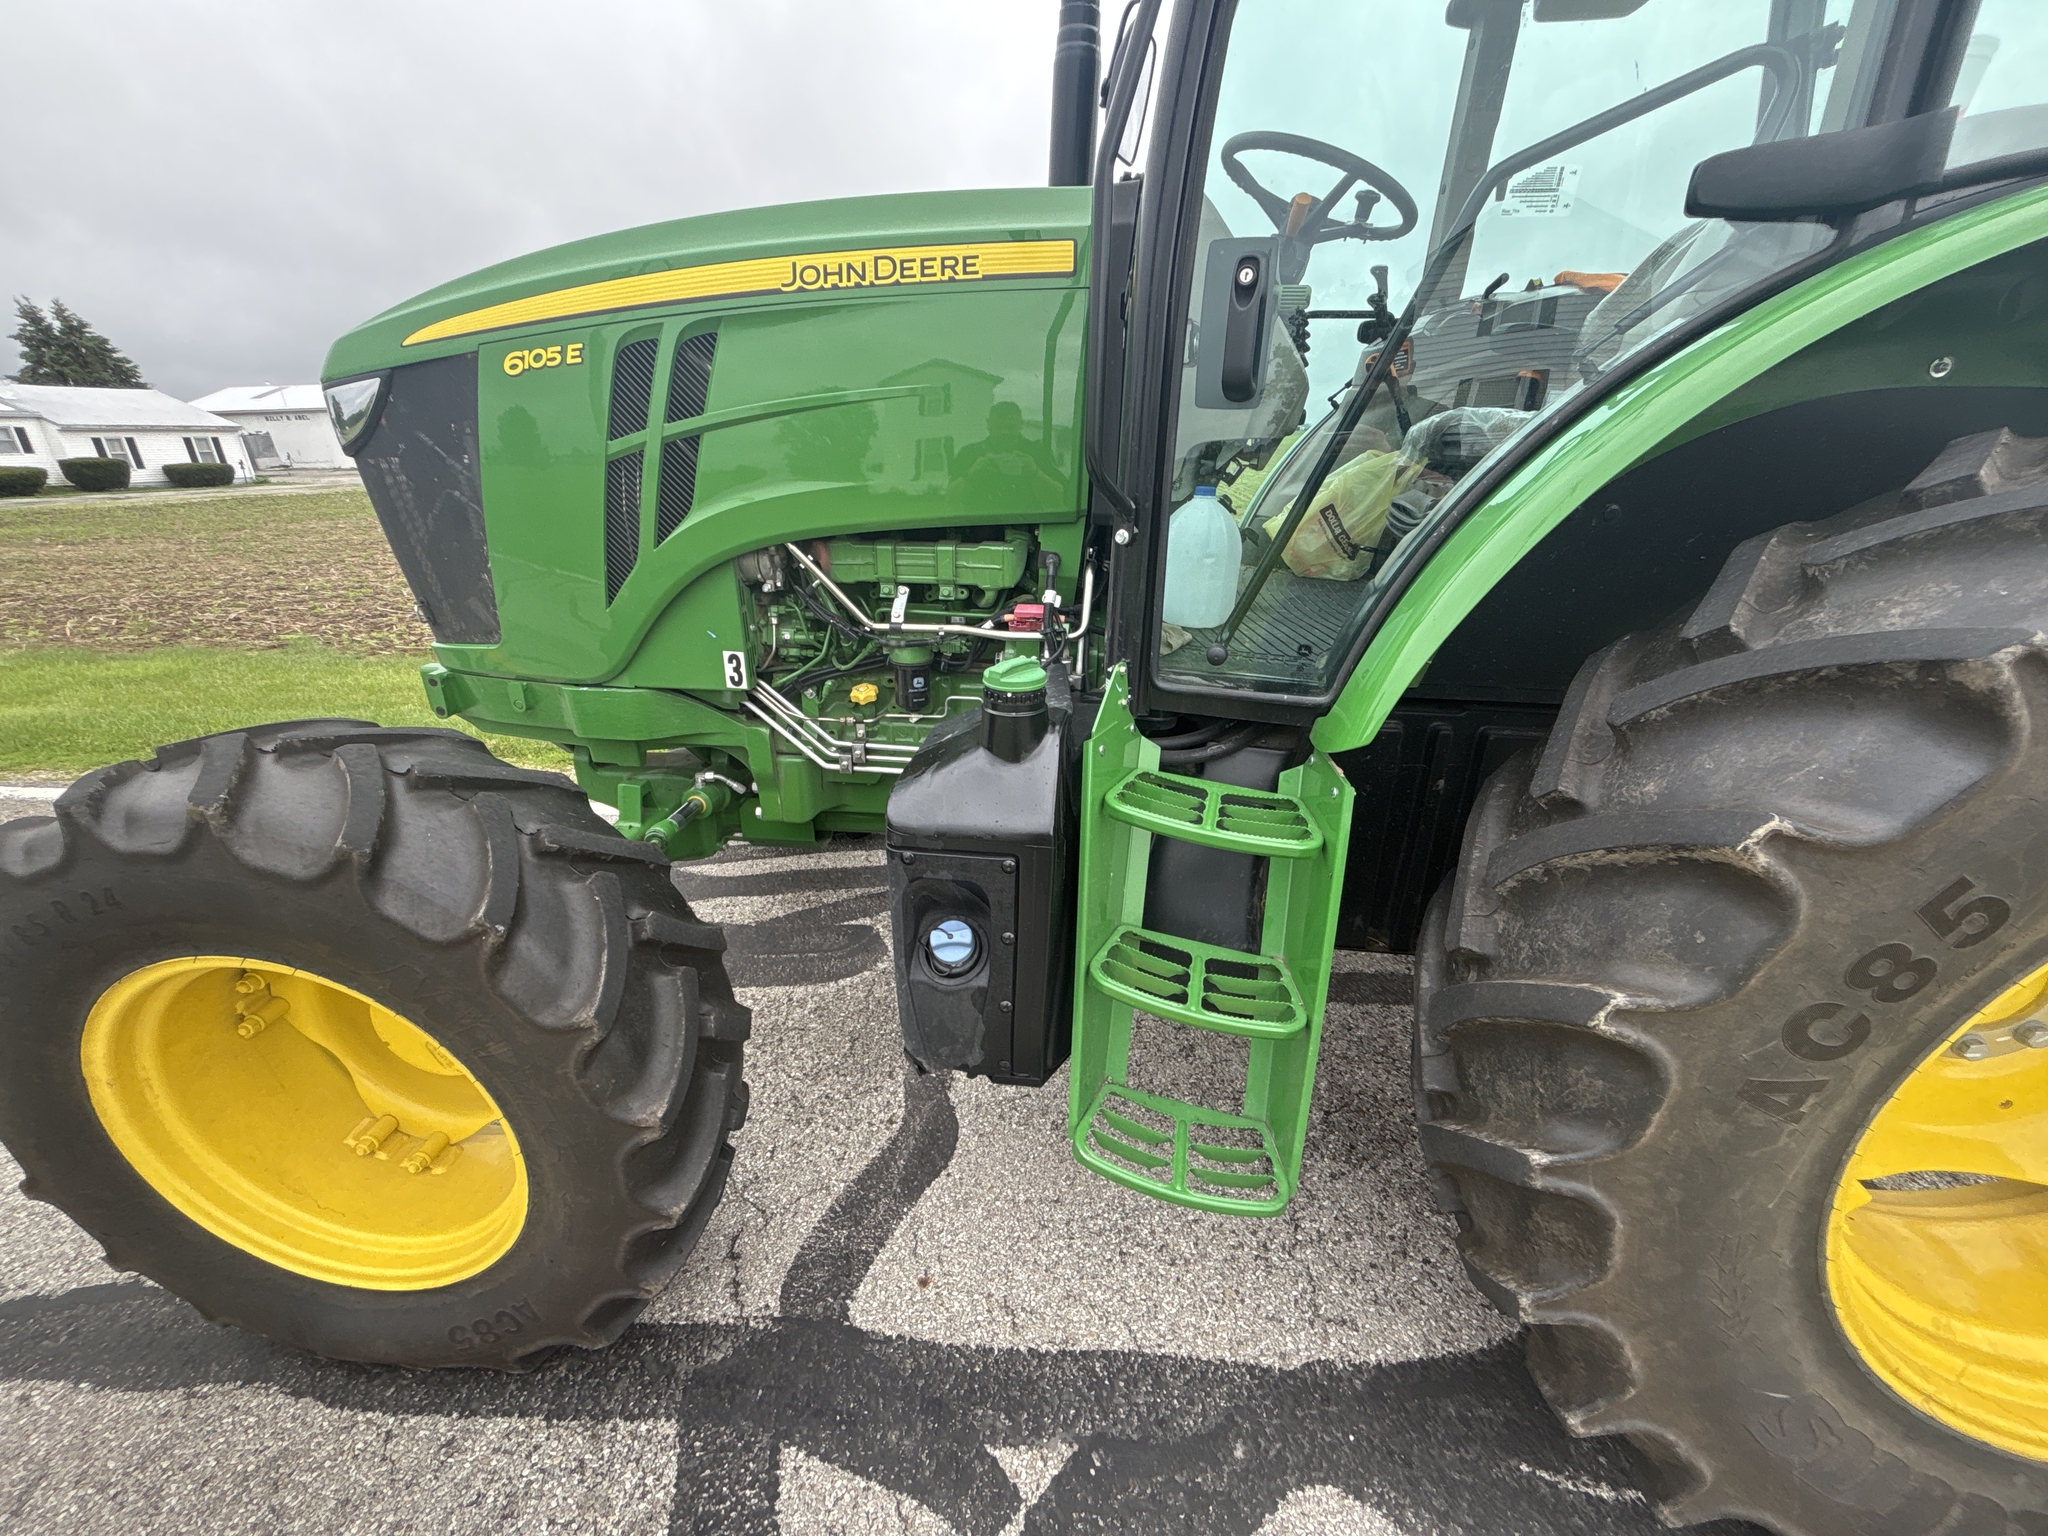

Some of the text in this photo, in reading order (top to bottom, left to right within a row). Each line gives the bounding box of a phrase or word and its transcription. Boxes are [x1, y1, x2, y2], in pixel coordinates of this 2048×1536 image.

[780, 254, 980, 288] JOHN DEERE
[503, 342, 584, 376] 6105 E
[727, 653, 744, 688] 3
[1735, 873, 2011, 1126] AC85
